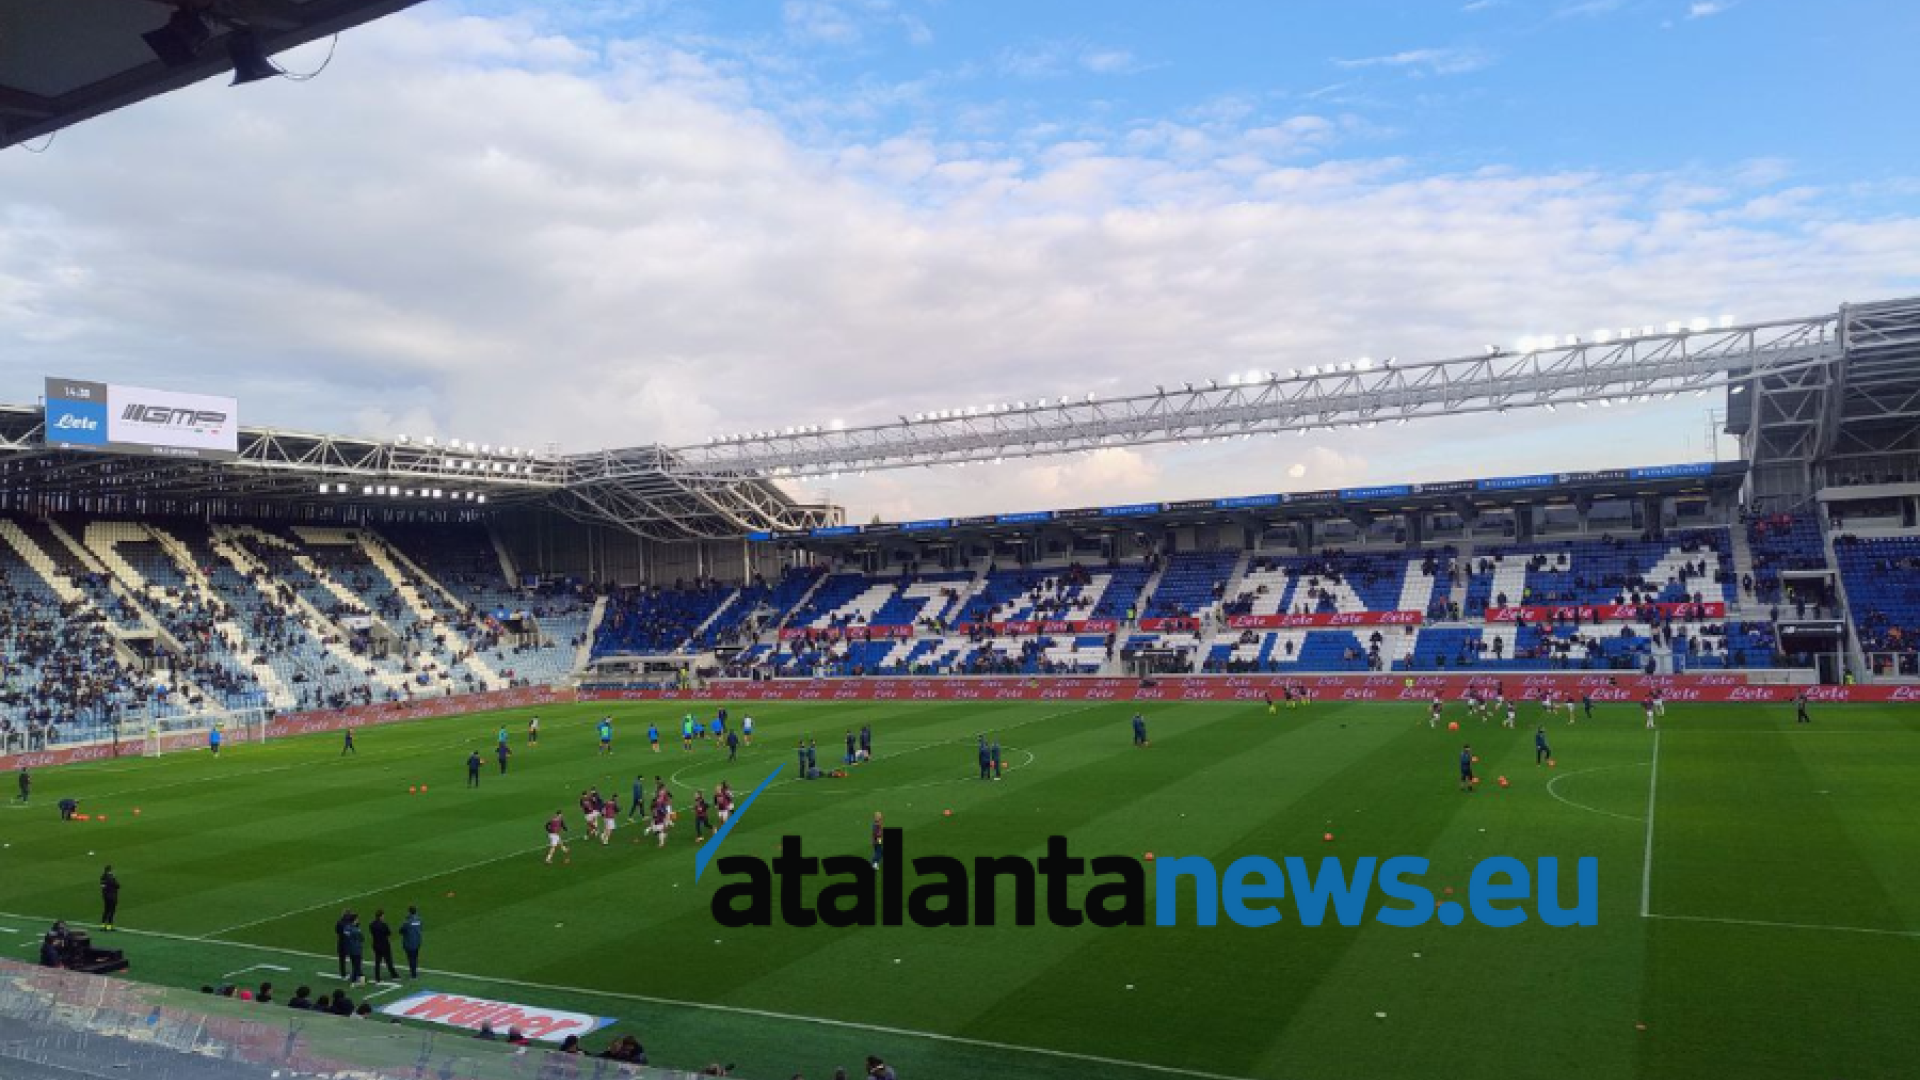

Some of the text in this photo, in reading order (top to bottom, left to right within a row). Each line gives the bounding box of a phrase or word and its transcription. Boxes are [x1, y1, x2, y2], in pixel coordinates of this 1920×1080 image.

[52, 413, 99, 431] Lete
[142, 406, 227, 426] GMP
[1232, 615, 1266, 627] Lete
[1327, 612, 1363, 625] Lete
[1375, 611, 1415, 623] Lete
[1725, 686, 1773, 700] Lete
[1804, 686, 1849, 700] Lete
